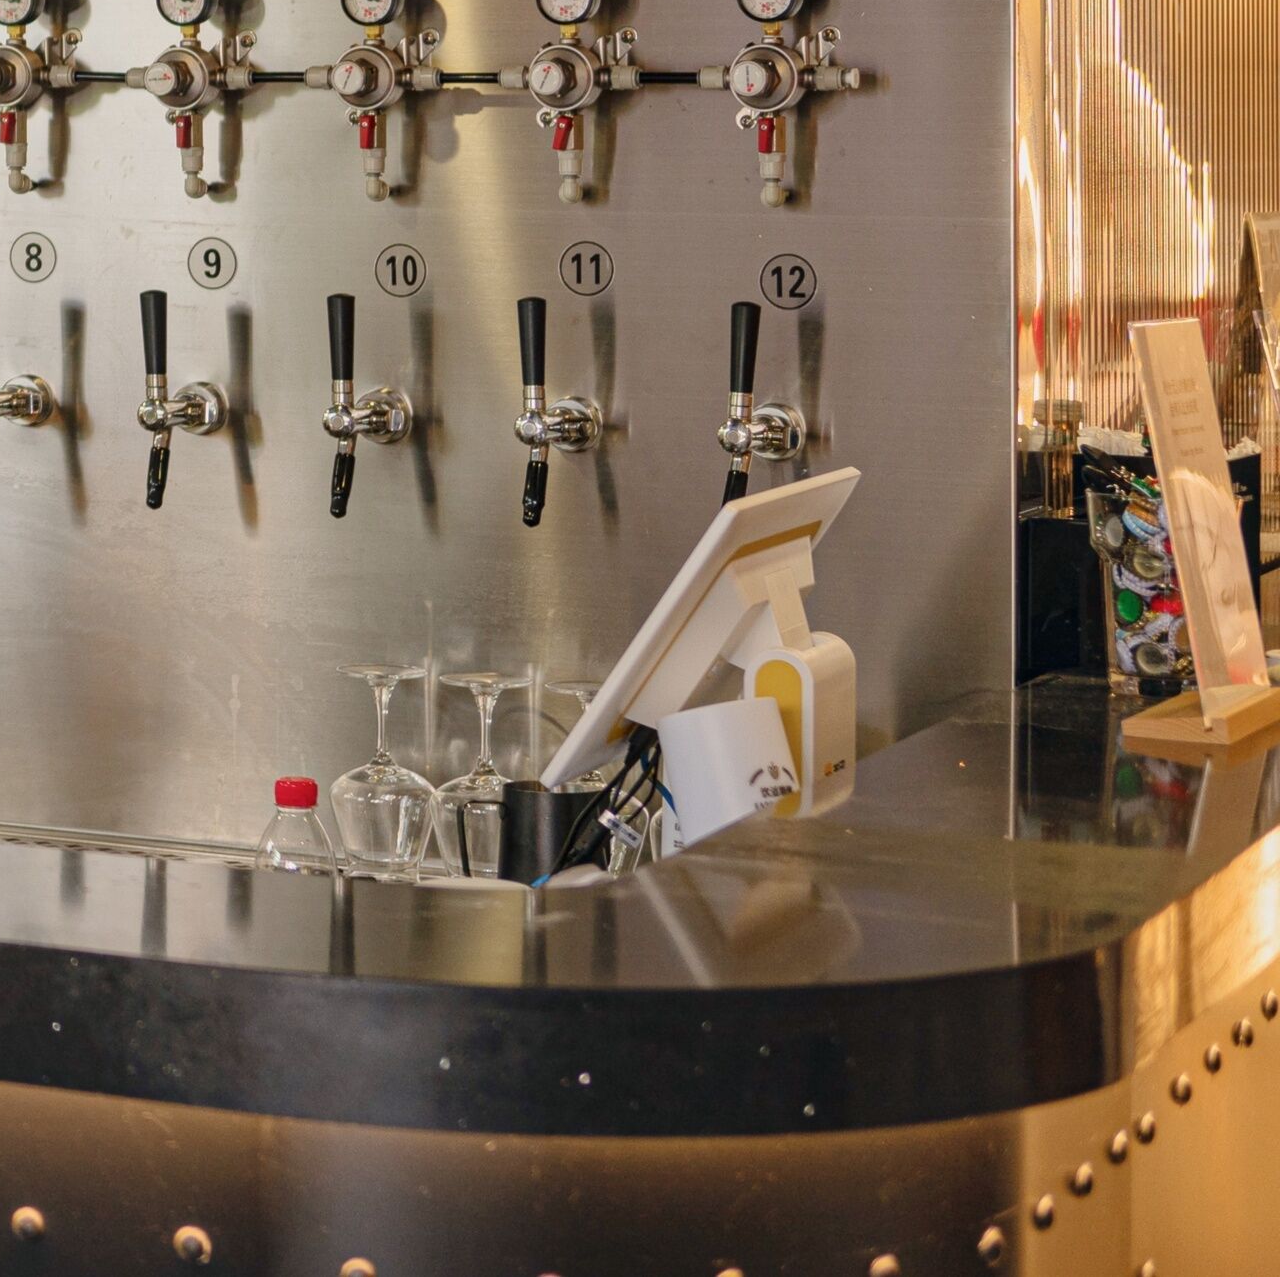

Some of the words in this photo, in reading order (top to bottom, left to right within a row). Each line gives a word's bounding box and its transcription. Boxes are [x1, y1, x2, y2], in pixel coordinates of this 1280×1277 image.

[24, 243, 42, 272] 8
[202, 247, 221, 279] 9
[385, 254, 418, 287] 10
[570, 253, 604, 286] 11
[769, 265, 806, 300] 12
